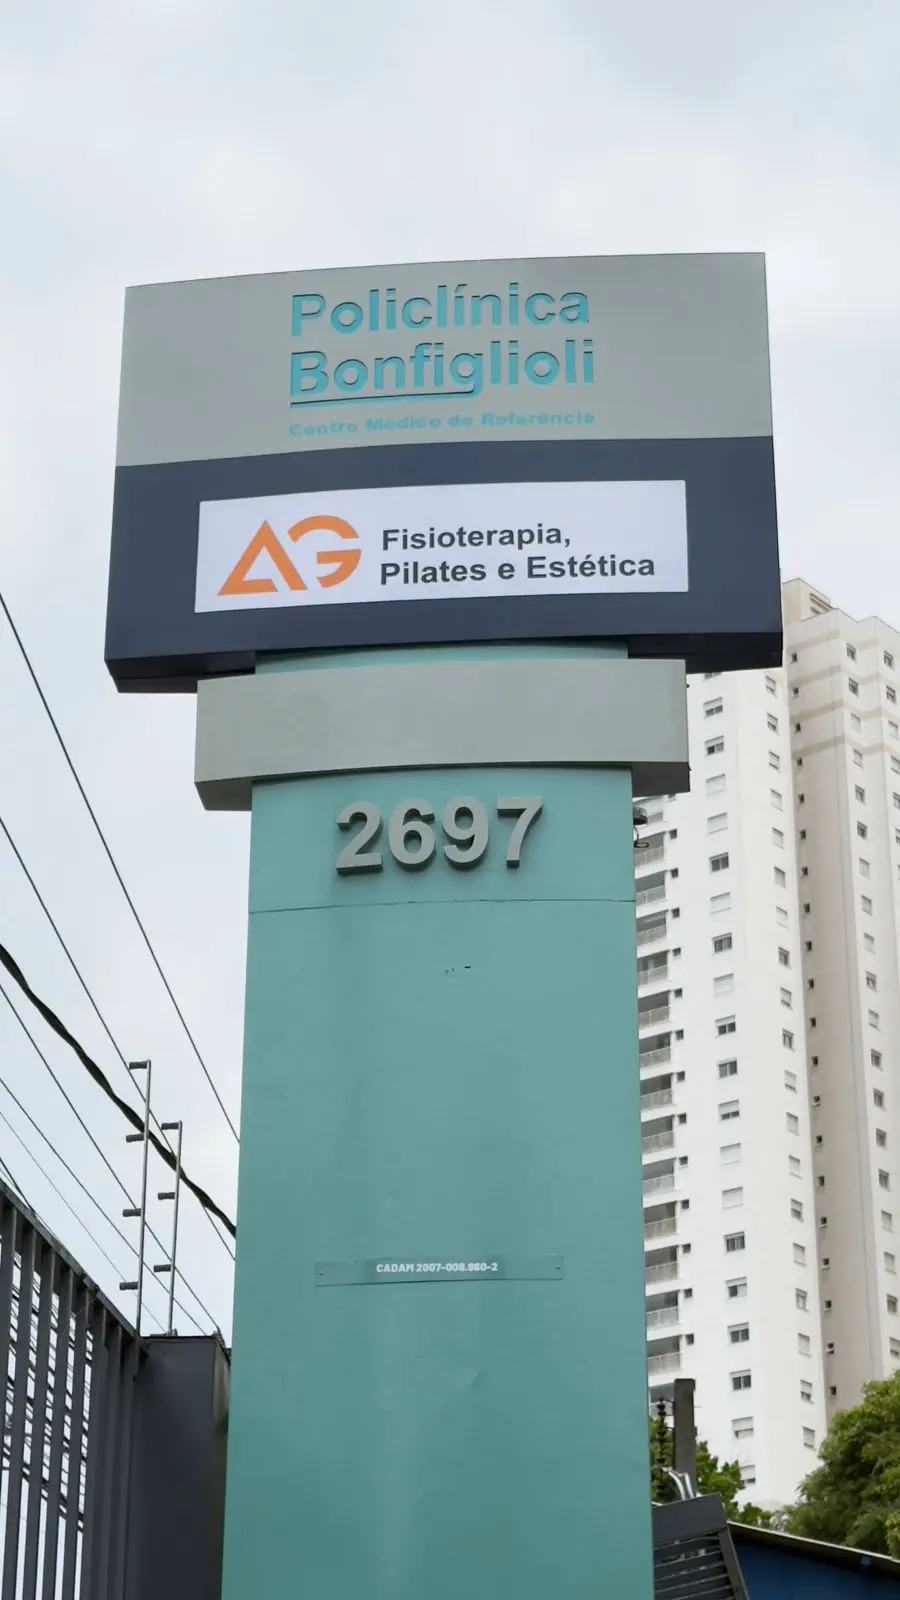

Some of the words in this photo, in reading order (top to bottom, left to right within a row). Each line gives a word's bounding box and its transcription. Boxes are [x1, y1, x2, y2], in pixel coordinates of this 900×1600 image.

[291, 282, 590, 337] Policlínica
[289, 339, 595, 399] Bonfiglioli
[288, 421, 358, 437] Centro
[447, 414, 474, 428] de
[382, 523, 571, 551] Fisioterapia,
[380, 560, 487, 586] Pilates
[497, 562, 515, 580] e
[527, 554, 656, 579] Estética
[335, 796, 545, 874] 2697
[376, 1263, 415, 1273] CADAM
